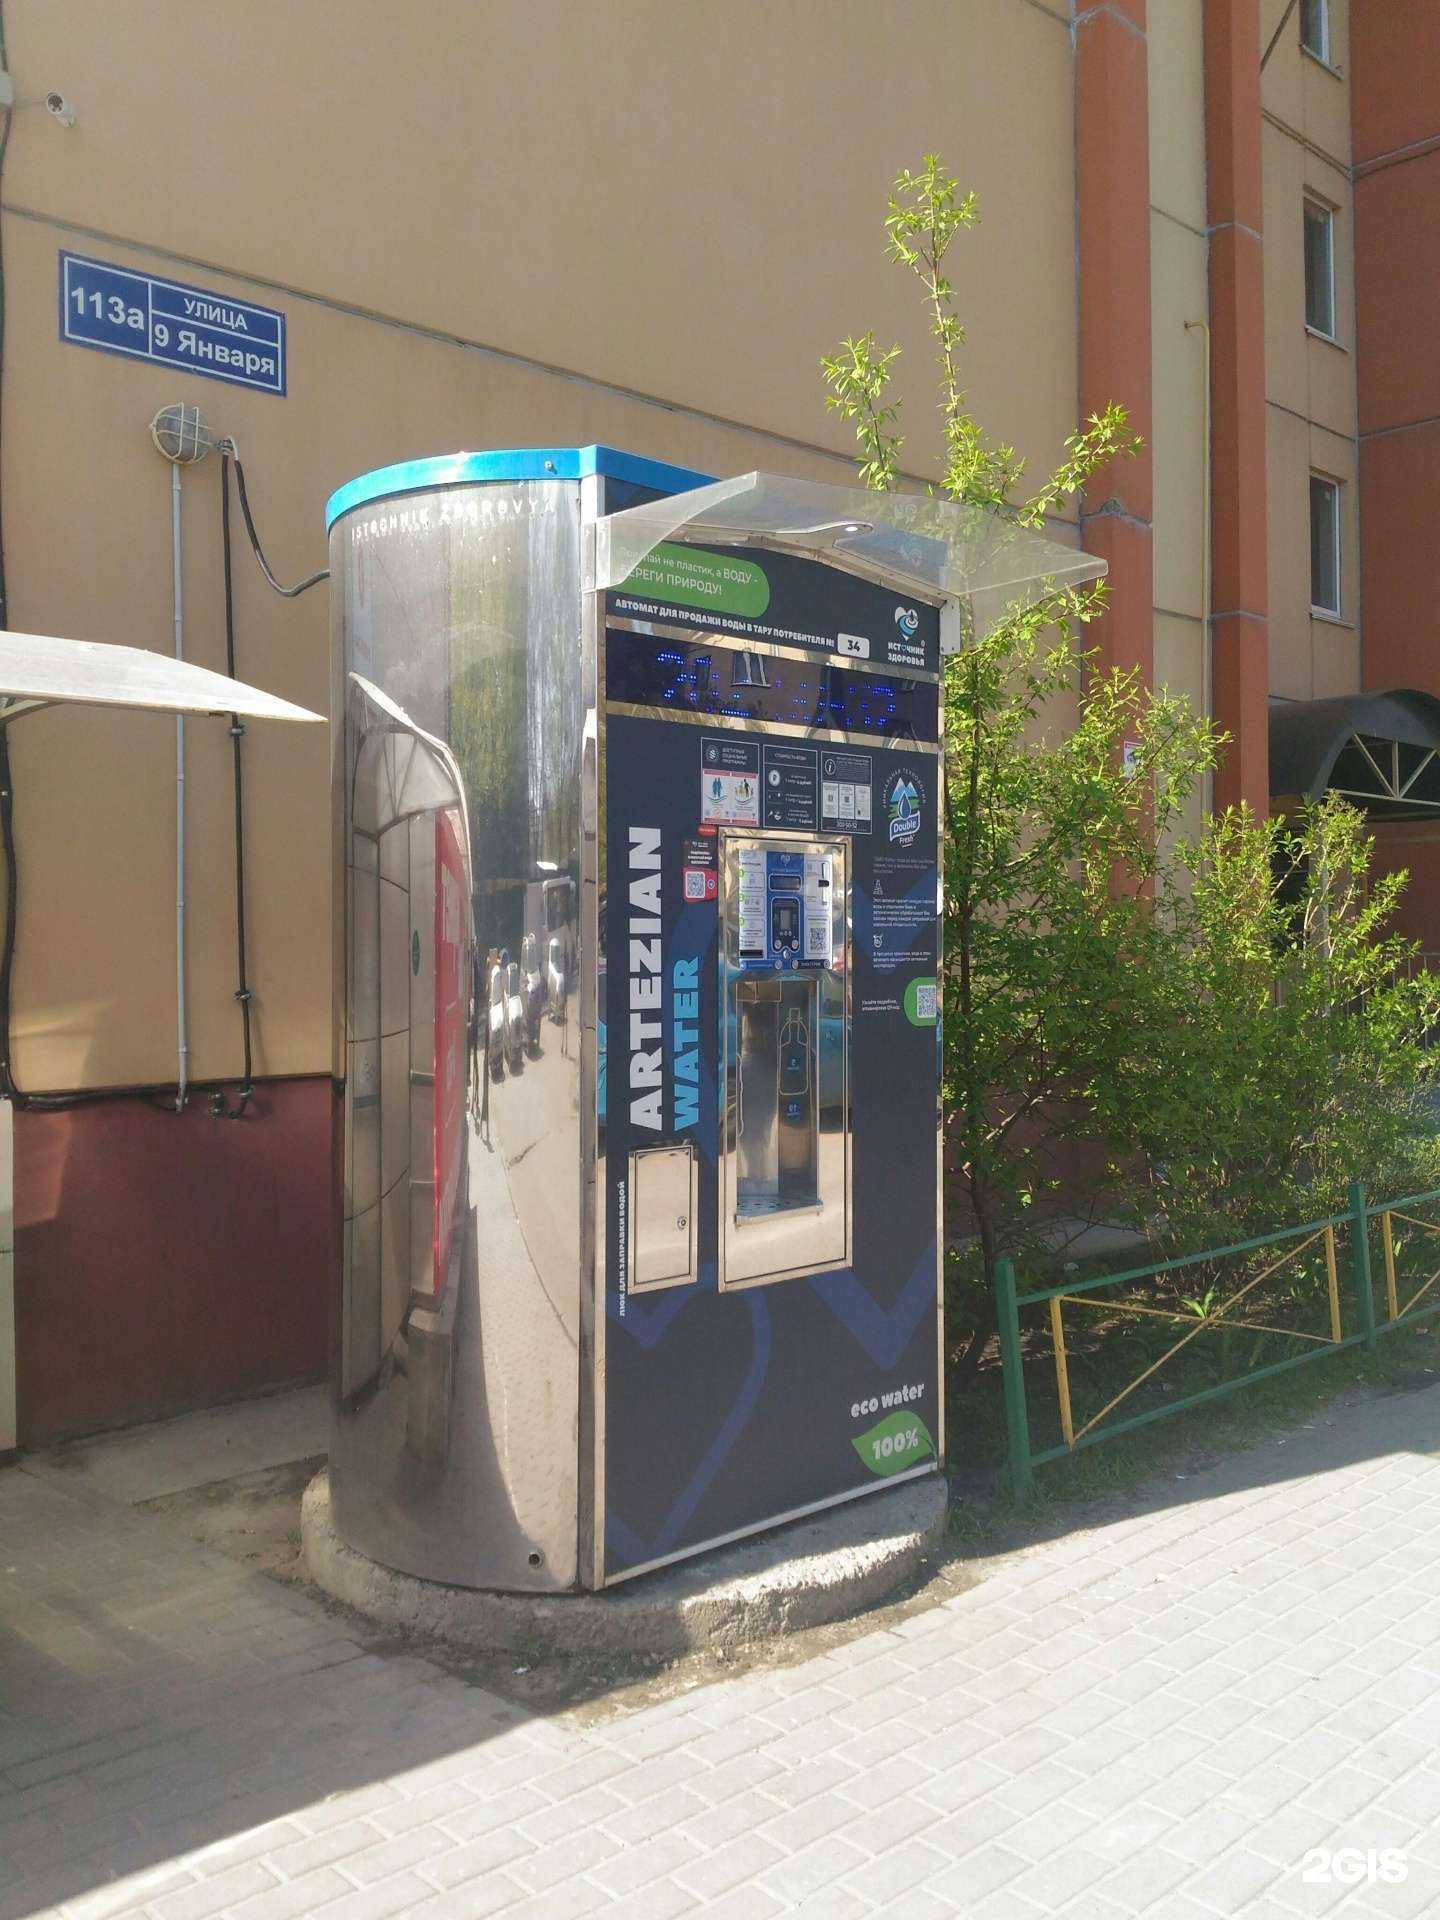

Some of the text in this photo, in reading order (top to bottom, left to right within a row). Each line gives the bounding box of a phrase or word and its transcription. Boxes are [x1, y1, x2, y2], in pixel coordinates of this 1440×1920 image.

[71, 286, 144, 330] 113а
[184, 298, 248, 330] УЛИЦА
[154, 324, 275, 375] 9 Января
[663, 557, 674, 566] не
[676, 560, 715, 577] пластик,
[723, 568, 752, 584] ВОДУ
[667, 574, 722, 595] ПРИРОДУ!
[615, 598, 658, 615] АВТОМАТ
[659, 606, 678, 618] ДЛЯ
[678, 610, 722, 627] ПРОДАЖИ
[722, 618, 746, 631] ВОДЫ
[747, 622, 753, 632] В
[754, 624, 772, 636] ТАРУ
[773, 628, 826, 646] ПОТРЕБИТЕЛЯ
[847, 639, 861, 652] 34
[887, 652, 925, 666] ЗДОРОВЬЯ
[893, 820, 917, 833] Double
[899, 834, 914, 845] Fresh
[629, 827, 663, 1131] ARTEZIAN
[673, 956, 699, 1131] WATER
[616, 1181, 626, 1217] ВОДОЙ
[618, 1218, 626, 1270] ЗАПРАВКИ
[618, 1294, 626, 1317] ЛЮК
[850, 1383, 925, 1418] eco water
[872, 1428, 919, 1460] 100%
